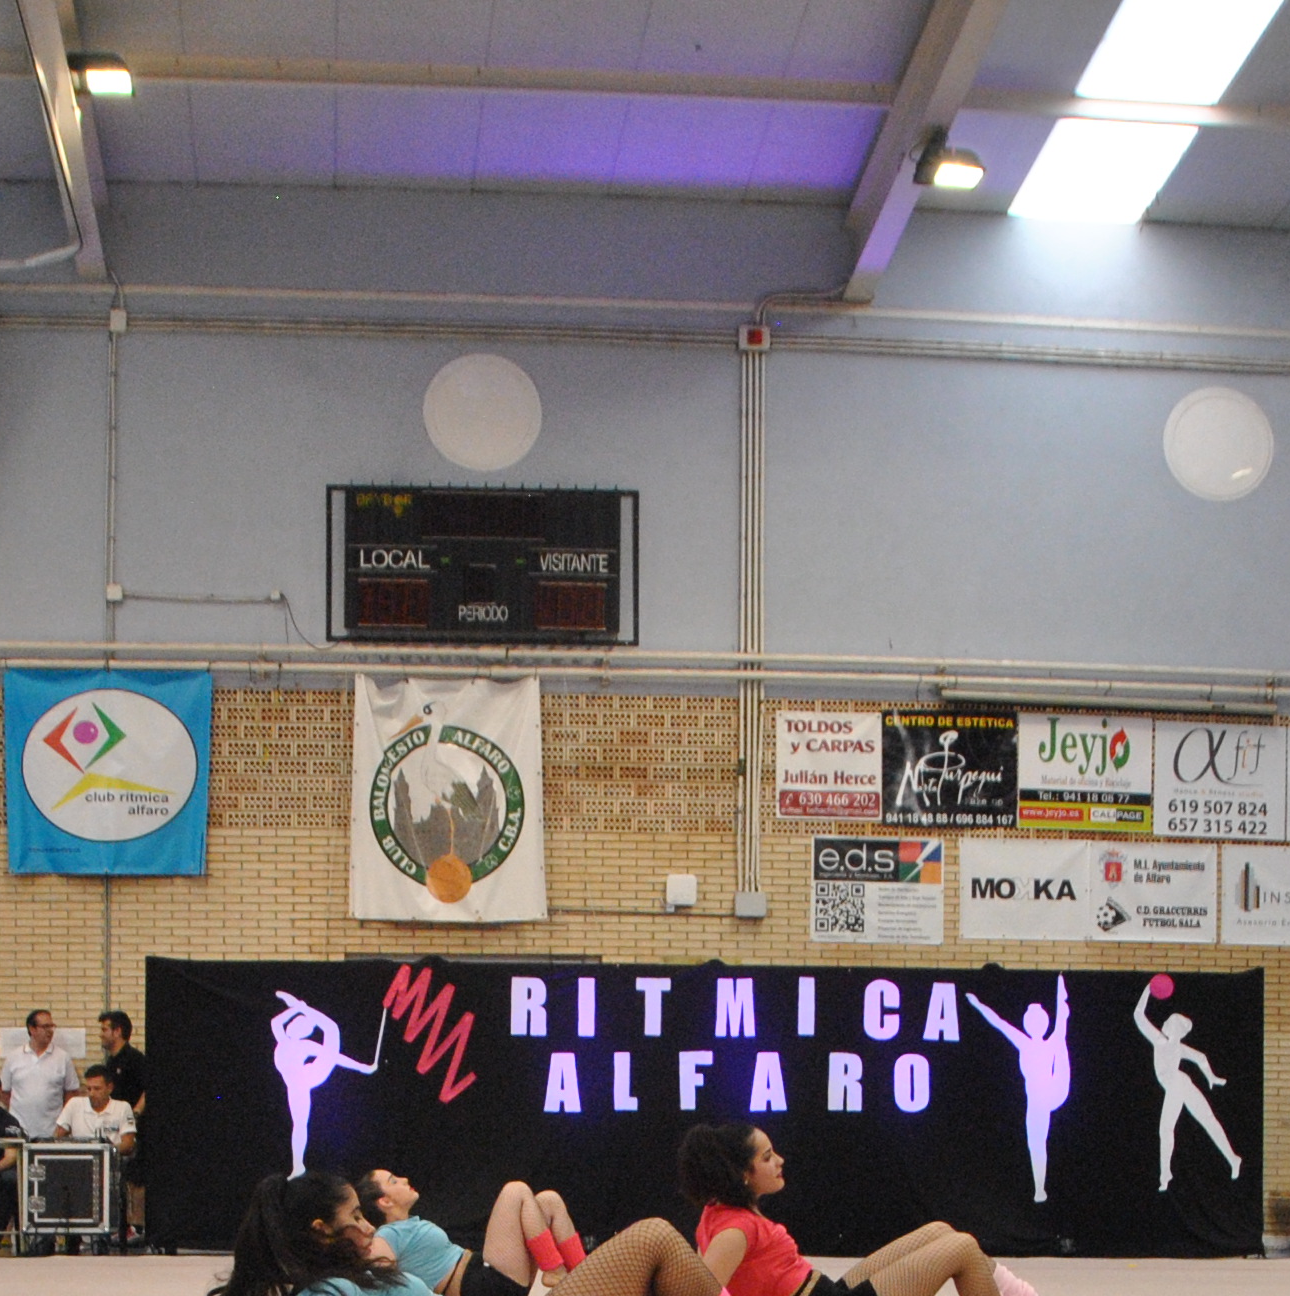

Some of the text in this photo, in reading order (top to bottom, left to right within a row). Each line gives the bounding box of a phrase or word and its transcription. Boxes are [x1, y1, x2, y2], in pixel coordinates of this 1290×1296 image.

[360, 549, 431, 569] LOCAL
[540, 553, 609, 573] VISITANTE
[459, 604, 509, 622] PERIODO
[785, 720, 853, 734] TOLDOS
[885, 715, 935, 727] CENTRO
[937, 716, 953, 727] DE
[790, 738, 875, 755] y CARPAS
[1038, 716, 1130, 777] Jeyjo
[833, 770, 877, 785] Herce
[84, 791, 115, 803] club
[382, 835, 417, 875] CLUB
[452, 729, 511, 774] ALFARO
[799, 792, 876, 807] 630 466 202
[1063, 792, 1081, 801] 941
[1086, 792, 1099, 802] 18
[1118, 794, 1130, 804] 77
[127, 804, 169, 816] alfaro
[1168, 799, 1268, 817] 619 507 824
[885, 812, 904, 823] 941
[996, 814, 1014, 825] 167
[1168, 817, 1268, 835] 657 315 422
[1134, 873, 1171, 884] de Alfaro
[1178, 918, 1201, 928] SALA
[510, 976, 960, 1042] RITMICA
[543, 1050, 931, 1113] ALFARO
